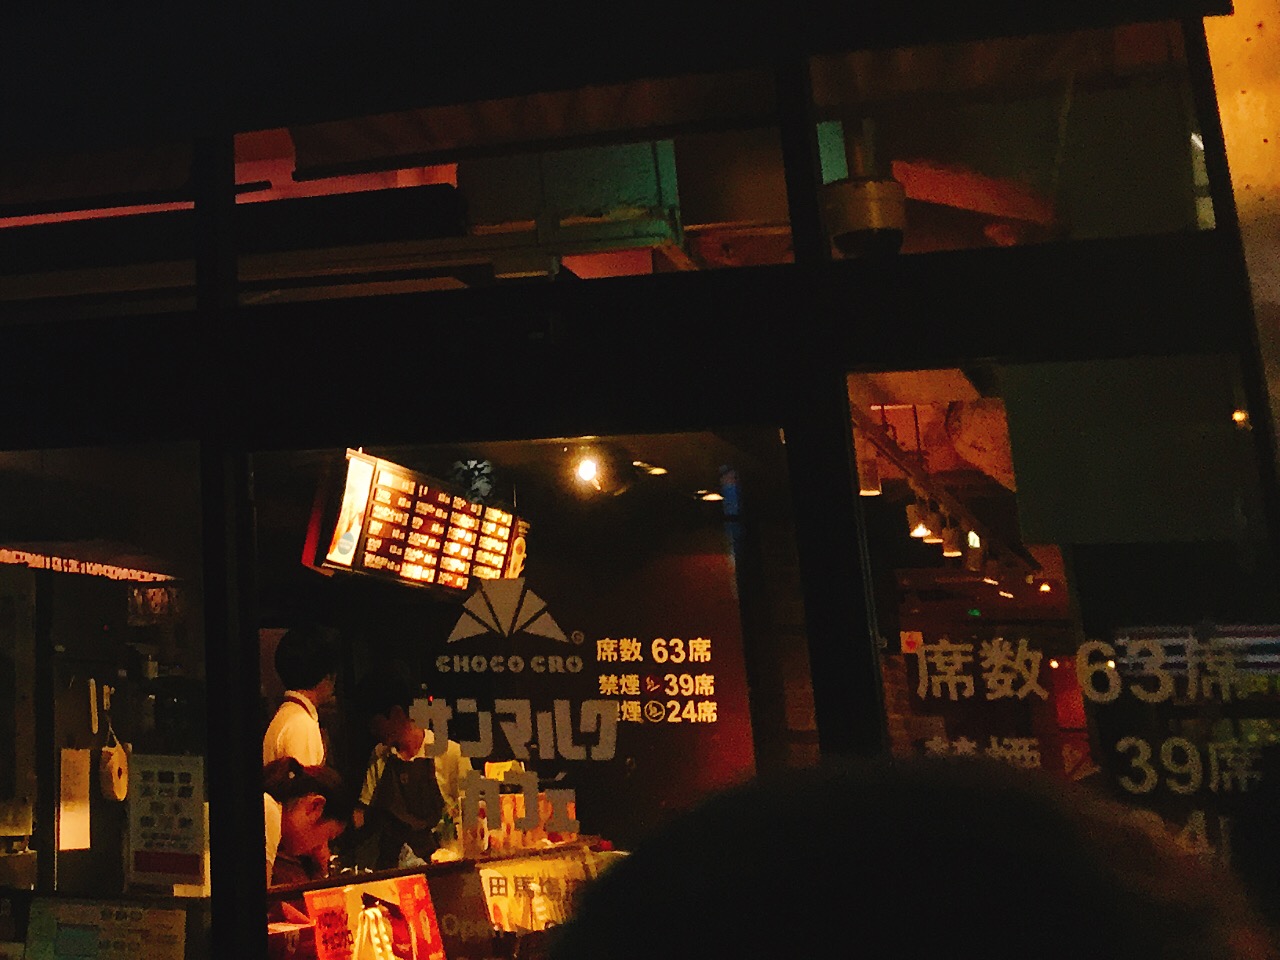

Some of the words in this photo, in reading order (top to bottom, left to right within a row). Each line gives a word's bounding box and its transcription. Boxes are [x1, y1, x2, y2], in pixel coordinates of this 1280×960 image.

[435, 653, 525, 674] CHOCO
[530, 654, 584, 674] CRO
[595, 637, 644, 662] 席数
[651, 637, 712, 664] 63席
[916, 638, 1049, 702] 席数
[598, 673, 641, 695] 禁煙
[663, 673, 715, 696] 39席
[409, 697, 620, 761] サンマルク
[666, 700, 718, 723] 24席
[1116, 736, 1263, 796] 39席
[460, 768, 580, 834] カフェ
